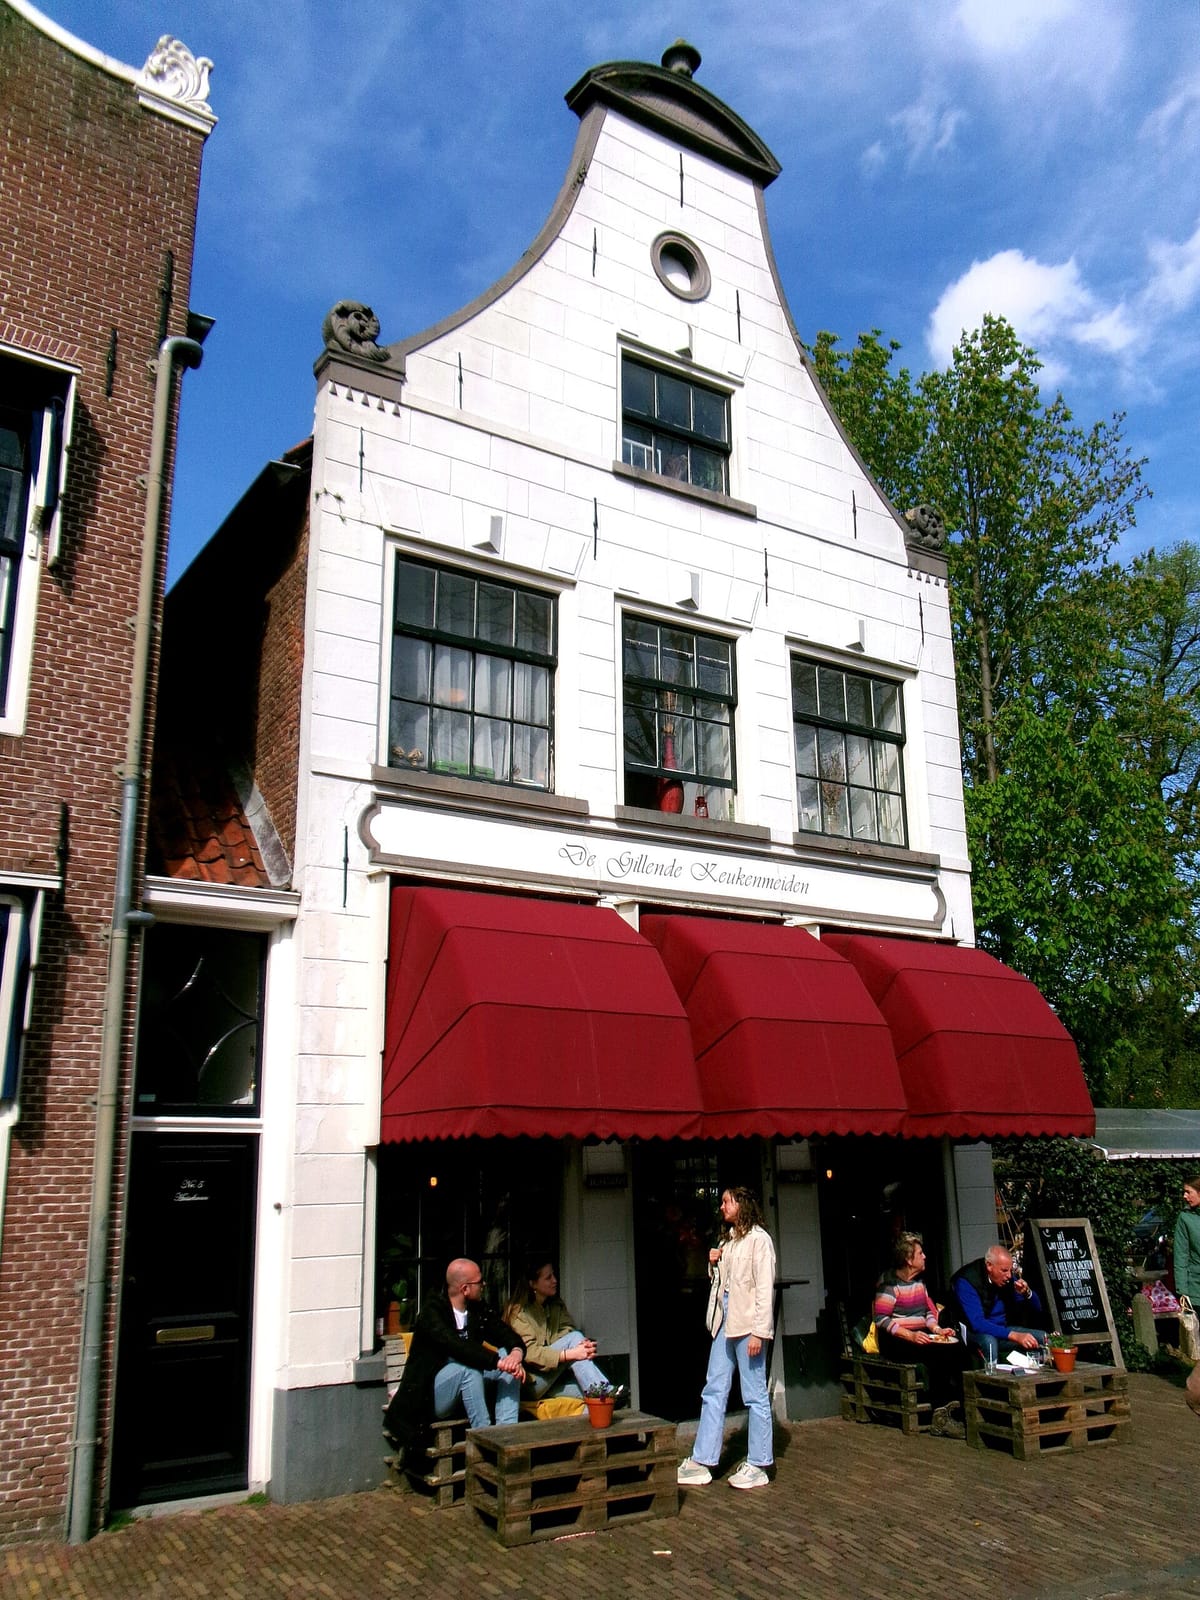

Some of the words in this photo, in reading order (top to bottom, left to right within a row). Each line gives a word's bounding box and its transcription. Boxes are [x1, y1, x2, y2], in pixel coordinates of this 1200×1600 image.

[558, 843, 597, 867] De
[606, 851, 683, 878] Gillende
[690, 862, 810, 895] Keukenmeiden
